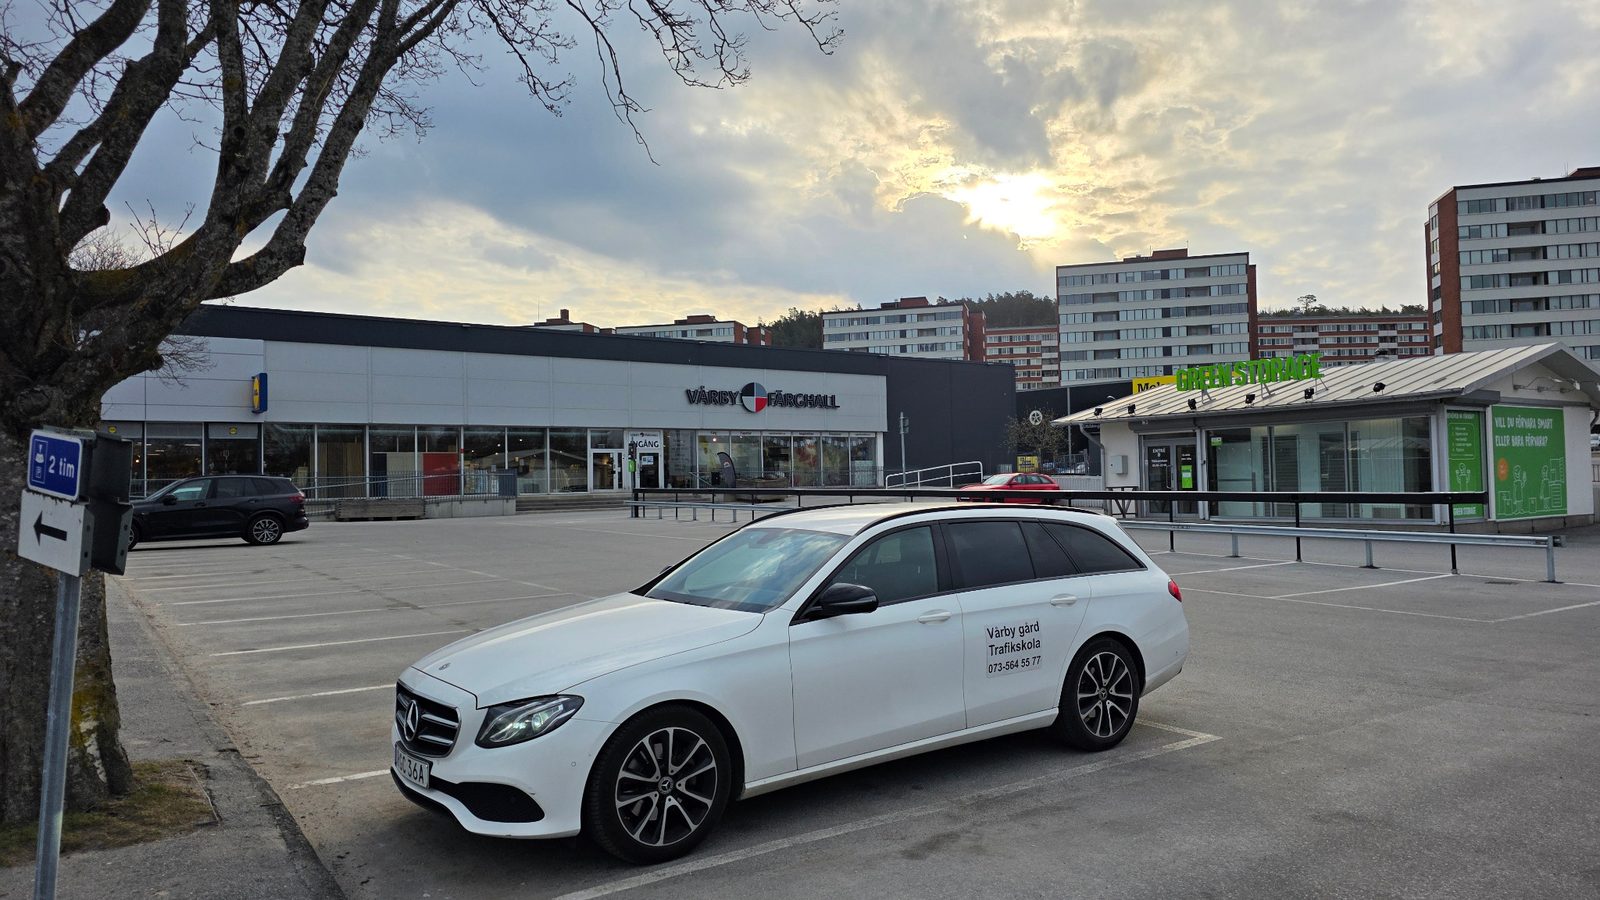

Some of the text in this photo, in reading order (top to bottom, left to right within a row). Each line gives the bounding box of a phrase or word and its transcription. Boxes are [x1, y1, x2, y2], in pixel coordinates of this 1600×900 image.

[1176, 353, 1325, 391] GREEN STORAGE
[686, 385, 840, 409] VÅRBY FÄRGHALL
[1495, 414, 1553, 429] VILL DU FÖRVARA SMART
[1495, 435, 1511, 447] ELLER
[48, 455, 56, 474] 2
[59, 457, 75, 478] tim
[986, 621, 1040, 639] Vårby gård
[988, 638, 1041, 656] Trafikskola
[988, 655, 1041, 673] 073-564 55 77
[407, 759, 425, 784] 36A
